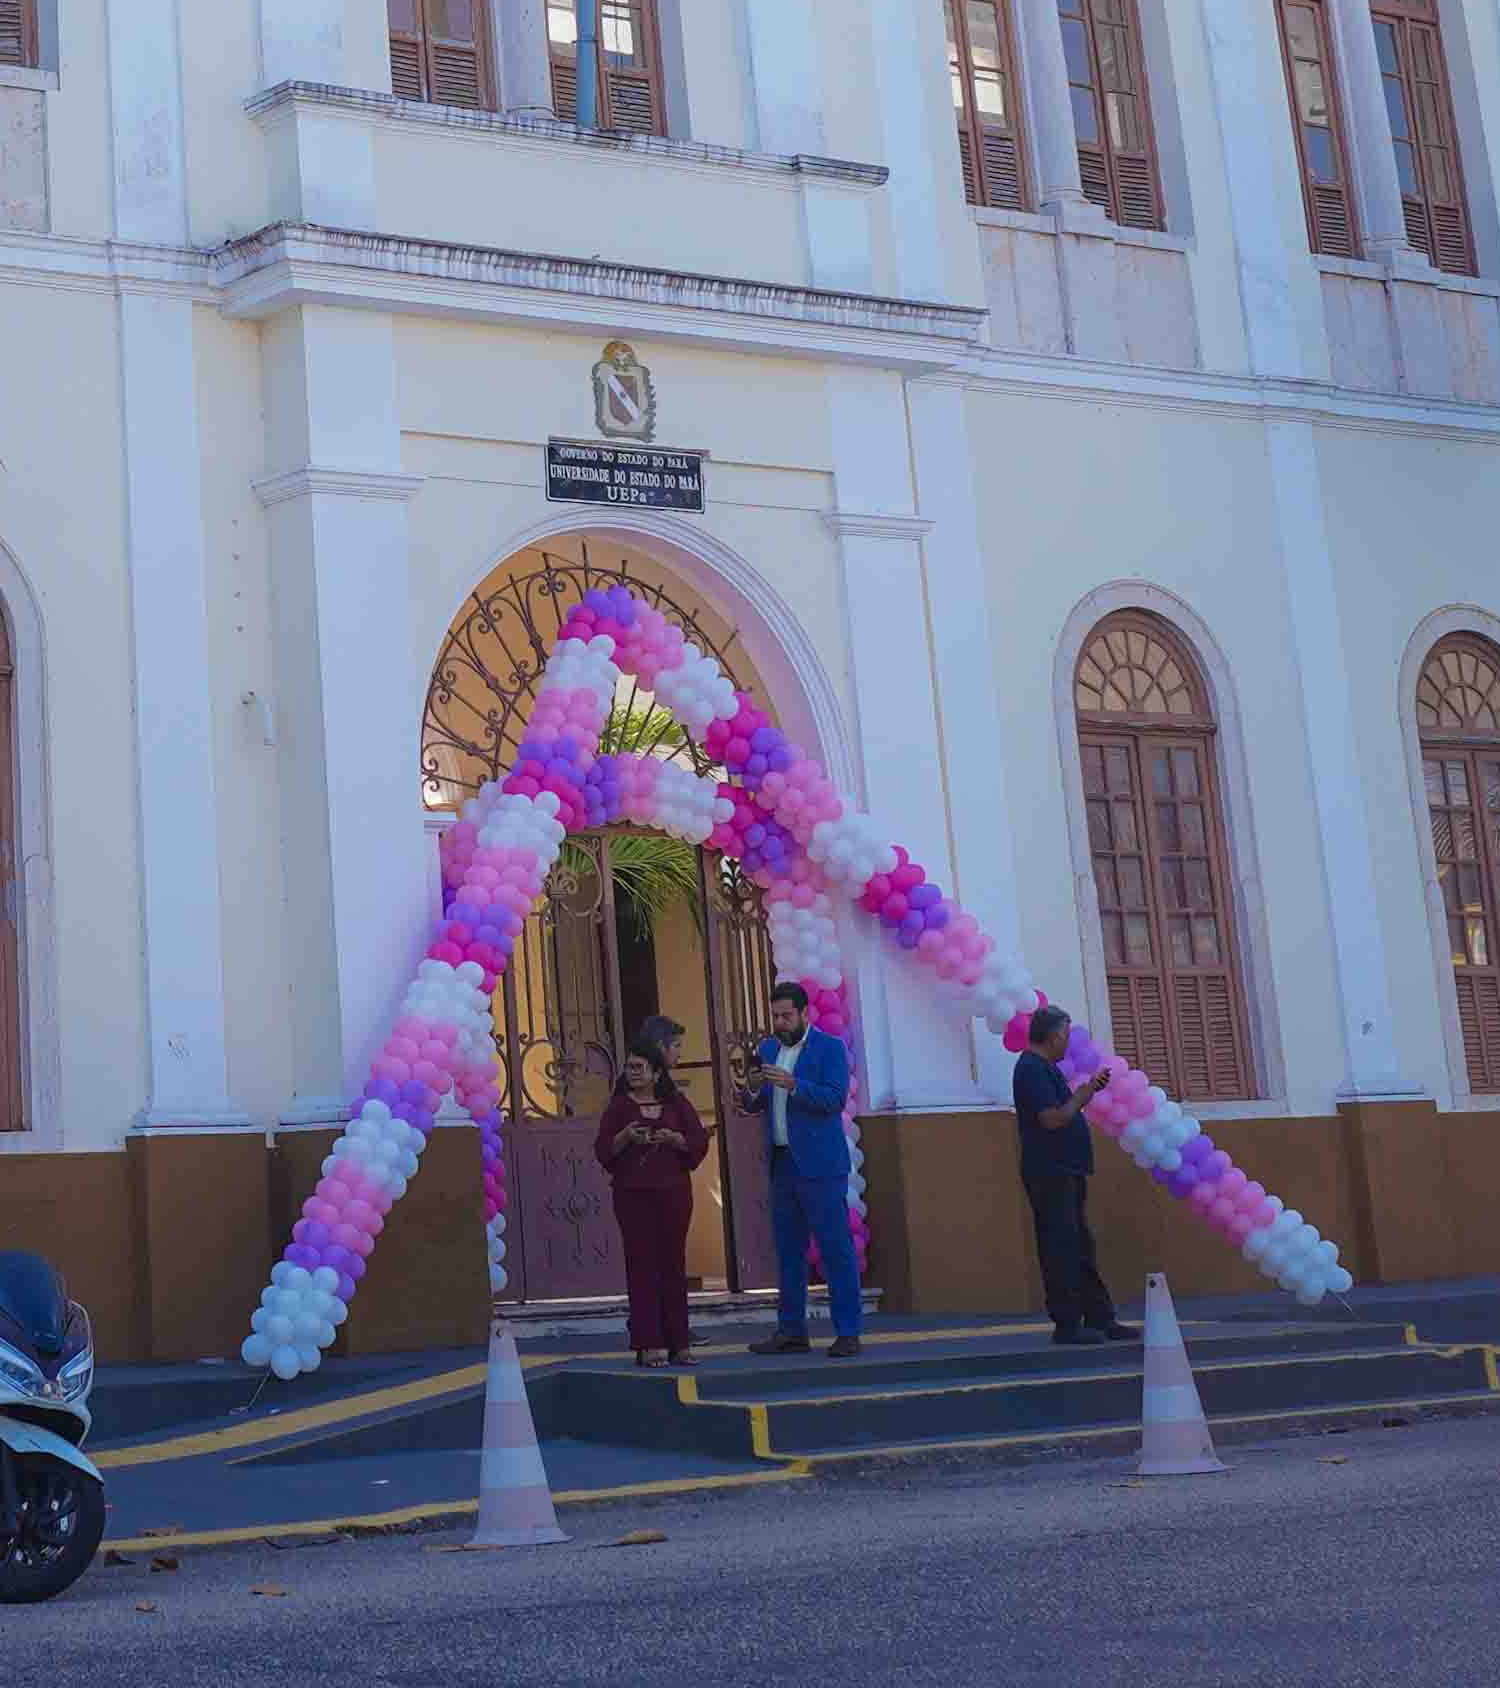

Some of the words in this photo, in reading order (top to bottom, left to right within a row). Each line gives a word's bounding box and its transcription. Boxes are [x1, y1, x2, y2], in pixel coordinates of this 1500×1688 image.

[560, 448, 597, 460] GOVERNO
[603, 452, 613, 462] DO
[618, 453, 648, 465] ESTADO
[653, 456, 664, 466] DO
[668, 455, 688, 469] PARÁ
[550, 464, 610, 482] UNIVERSIDADE
[615, 470, 625, 483] DO
[630, 472, 660, 487] ESTADO
[664, 475, 676, 488] DO
[679, 474, 699, 490] PARÁ
